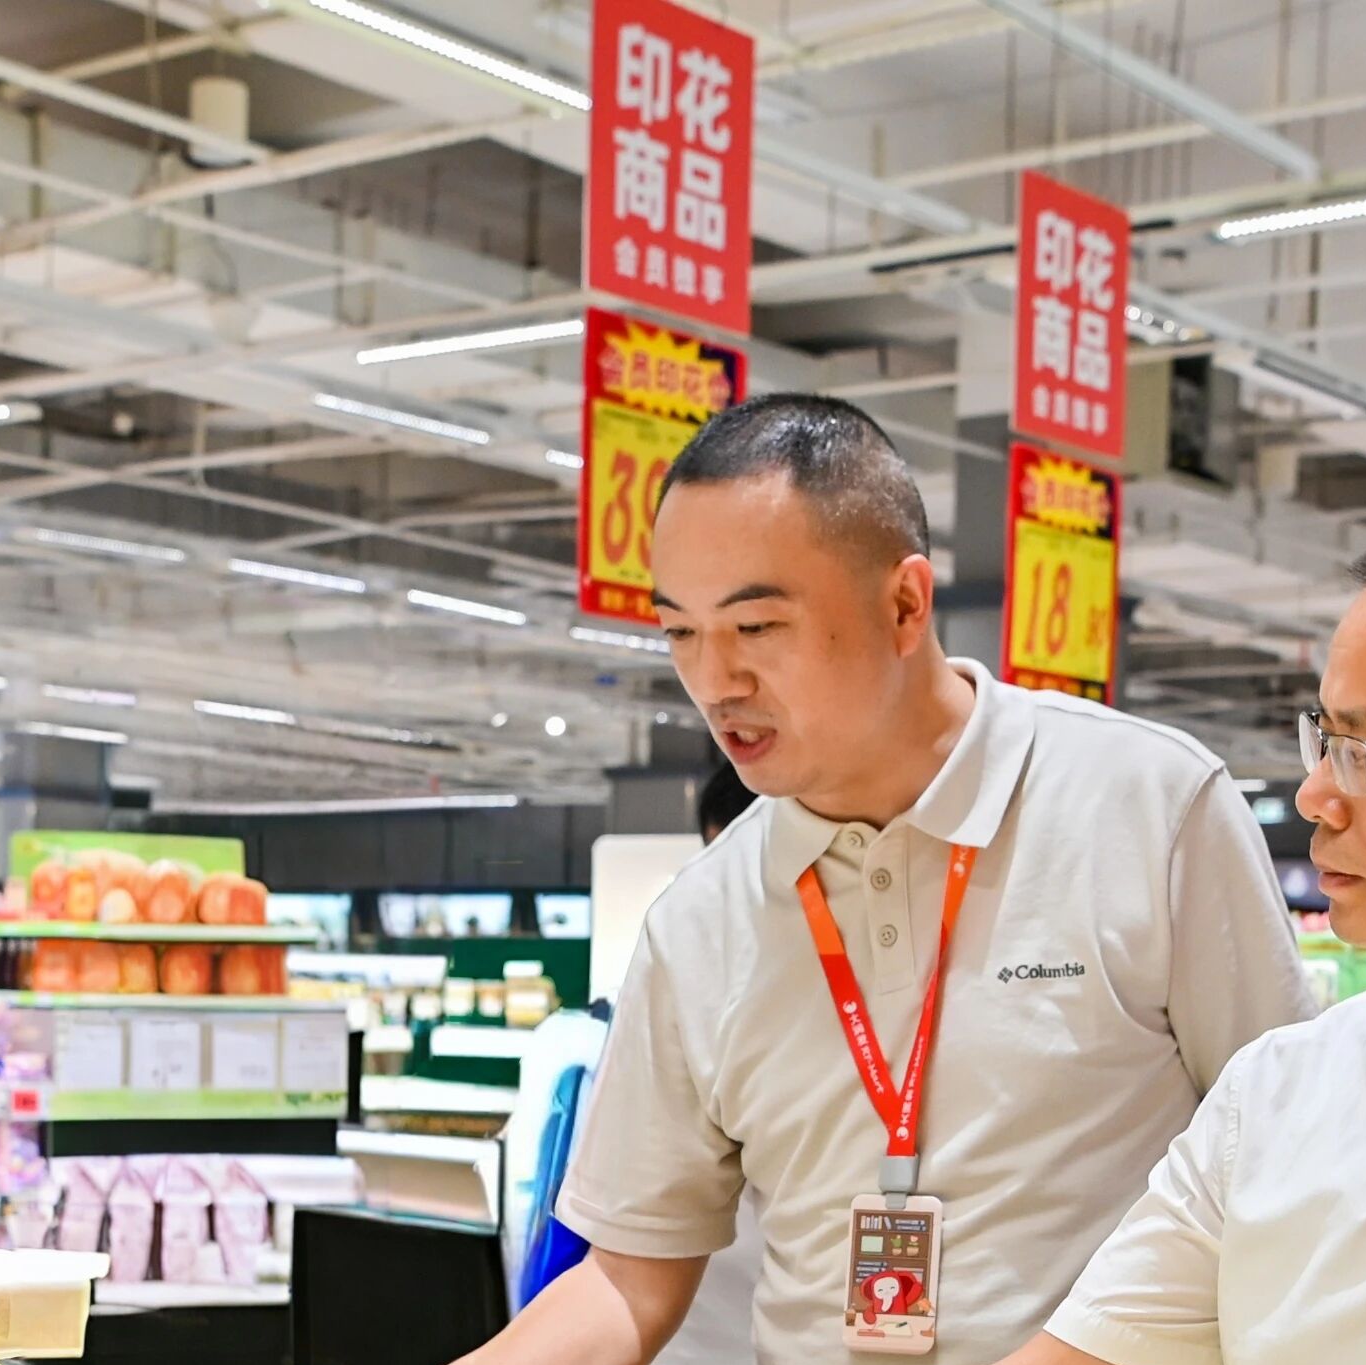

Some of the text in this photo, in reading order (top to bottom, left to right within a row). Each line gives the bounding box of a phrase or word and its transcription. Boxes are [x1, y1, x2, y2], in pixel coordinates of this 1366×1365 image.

[616, 23, 732, 152] 印花
[612, 128, 727, 251] 商品
[1036, 209, 1116, 312] 印花
[1032, 296, 1111, 392] 商品
[1024, 561, 1073, 657] 18
[1014, 961, 1086, 982] Columbia
